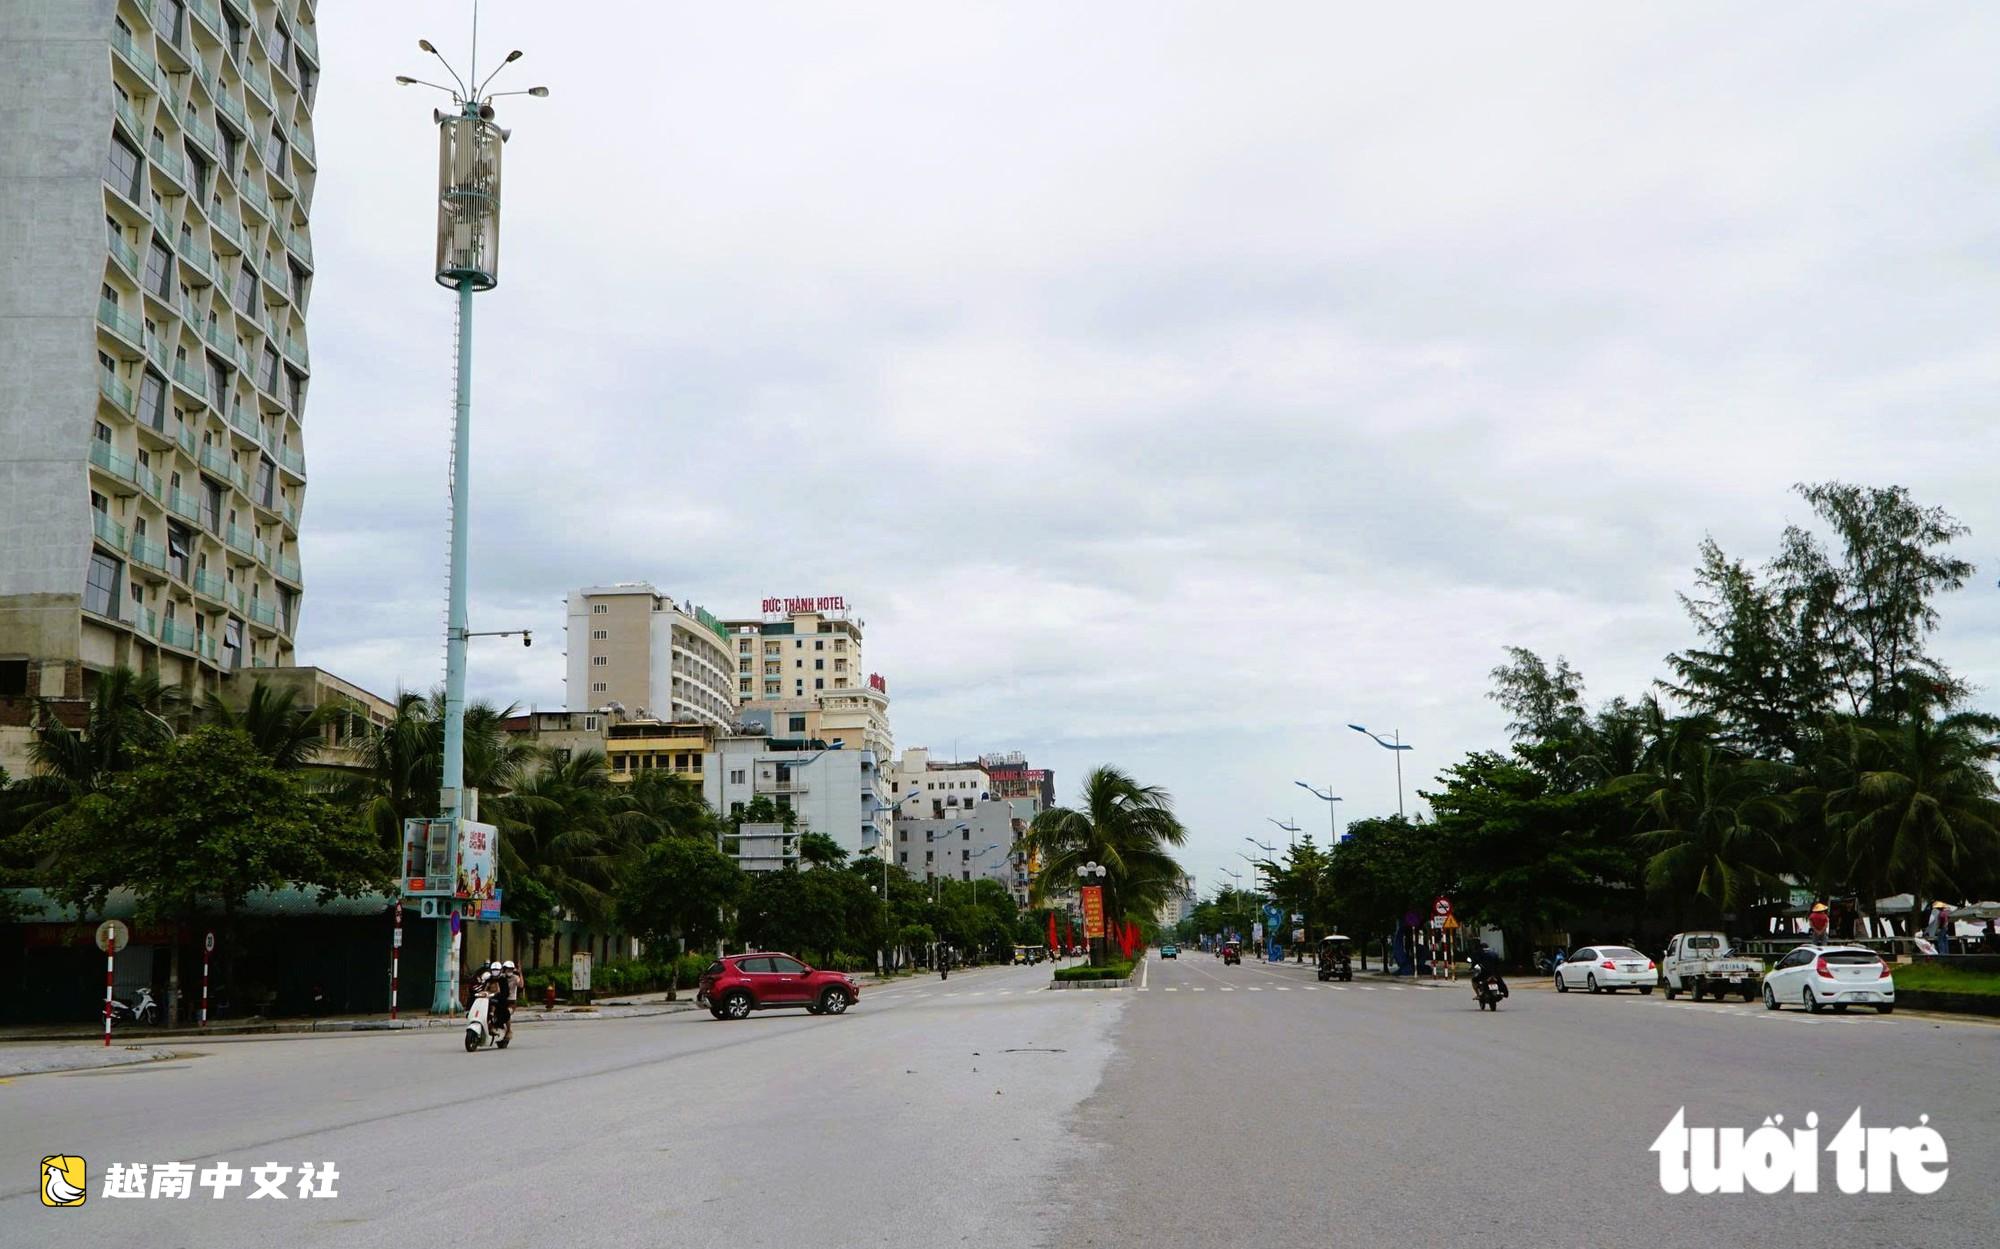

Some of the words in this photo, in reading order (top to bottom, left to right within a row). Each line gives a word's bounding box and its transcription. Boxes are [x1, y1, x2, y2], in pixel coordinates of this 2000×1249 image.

[763, 596, 781, 613] ĐỨC
[784, 595, 815, 612] THÀNH
[817, 596, 845, 610] HOTEL
